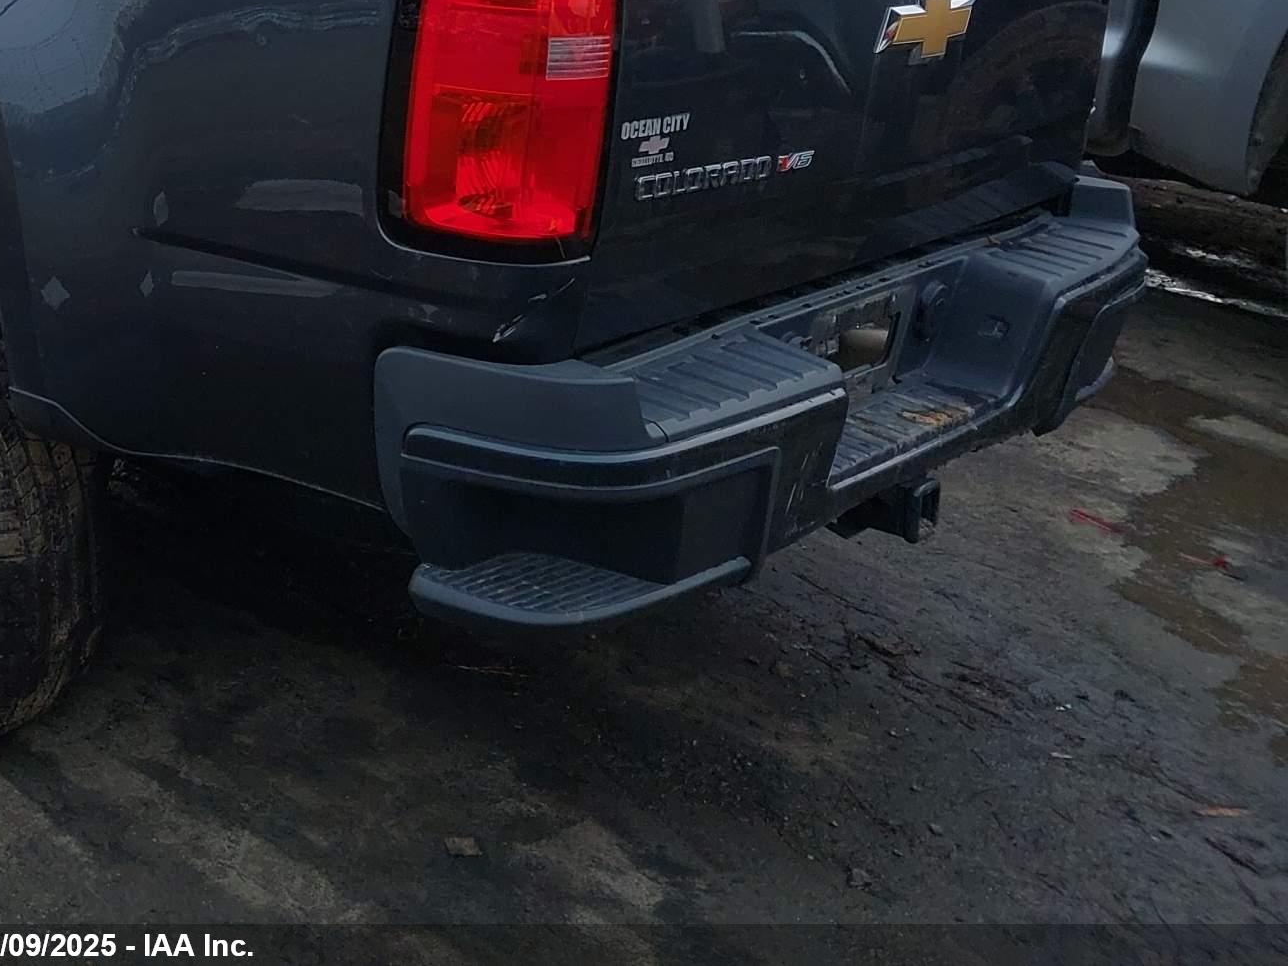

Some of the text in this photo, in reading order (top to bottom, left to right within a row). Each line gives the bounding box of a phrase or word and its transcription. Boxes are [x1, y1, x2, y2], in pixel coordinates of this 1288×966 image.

[620, 112, 691, 140] OCEAN CITY
[635, 155, 772, 201] COLORADO
